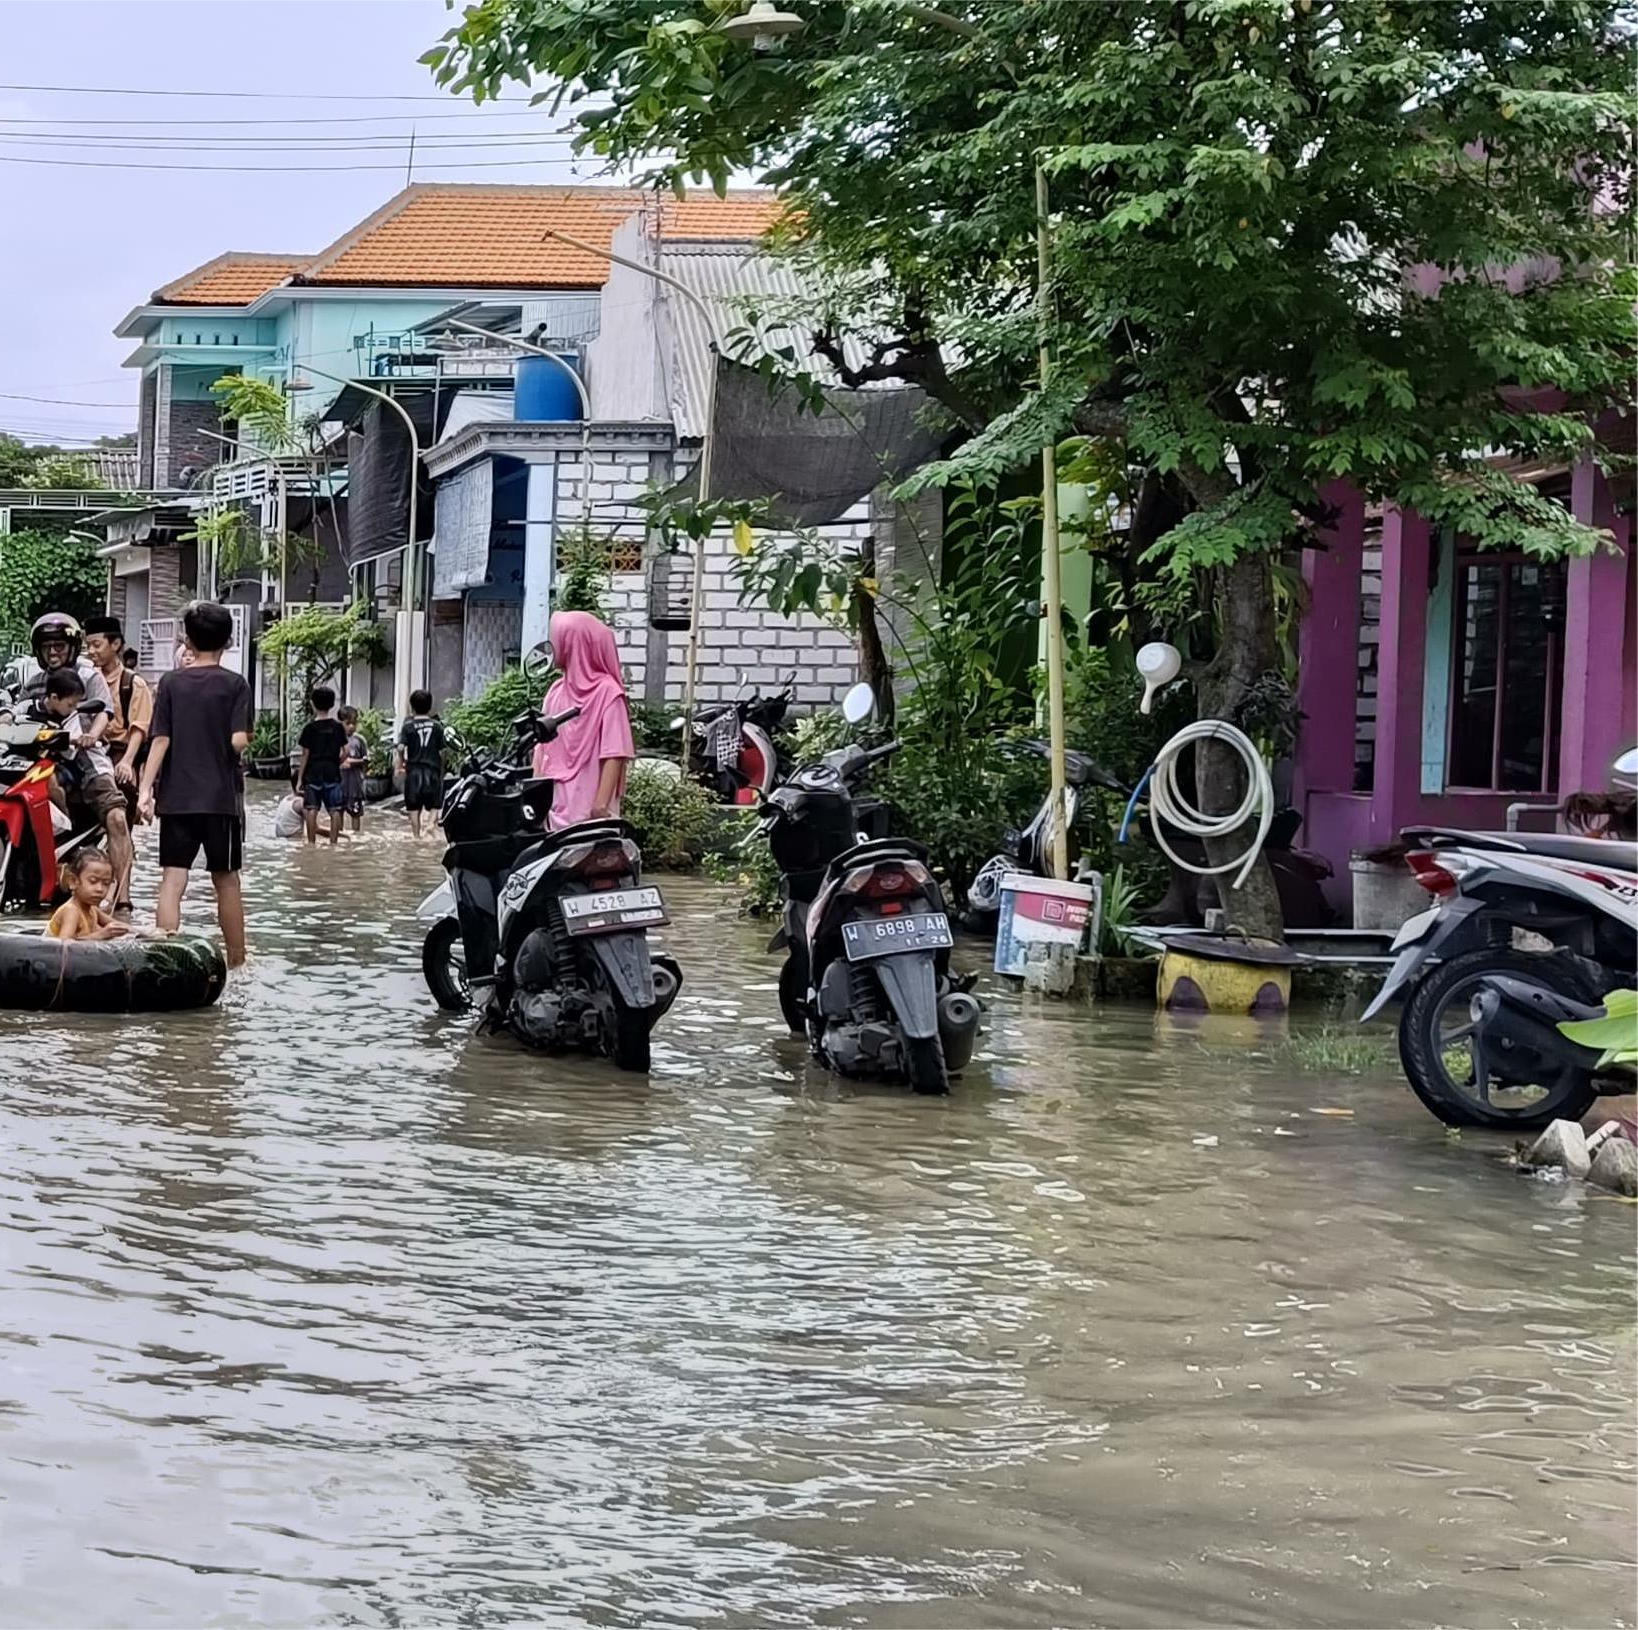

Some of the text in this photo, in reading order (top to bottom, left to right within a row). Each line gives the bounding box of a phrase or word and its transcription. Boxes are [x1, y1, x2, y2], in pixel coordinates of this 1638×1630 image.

[417, 727, 433, 748] 17
[566, 901, 580, 915] W
[591, 894, 626, 911] 4528
[846, 916, 946, 941] W 6898 AH
